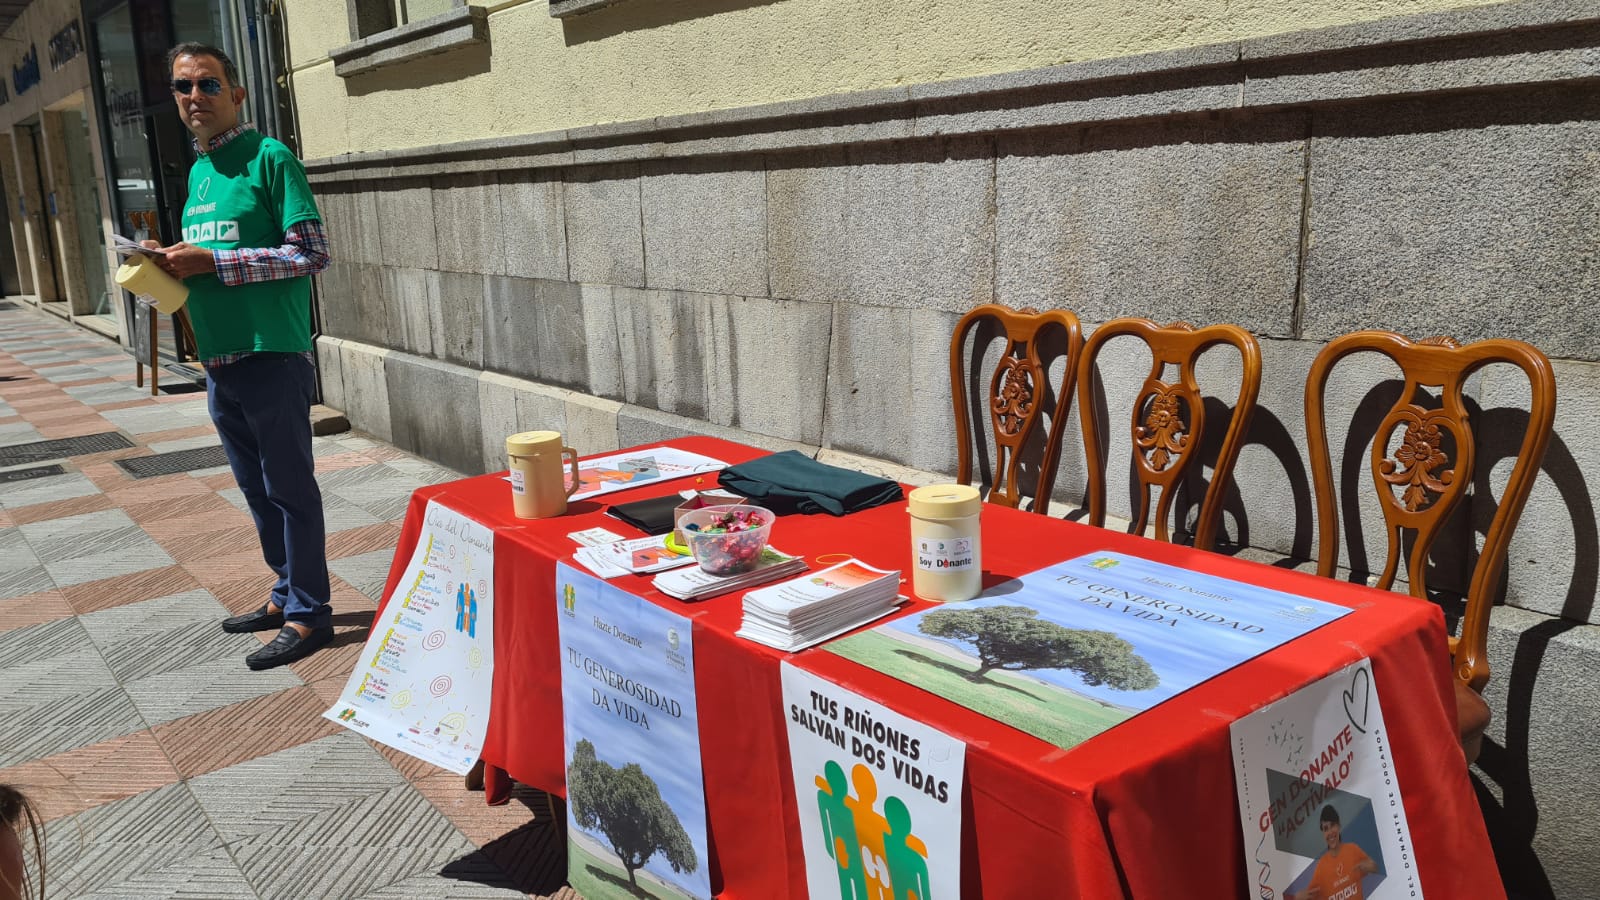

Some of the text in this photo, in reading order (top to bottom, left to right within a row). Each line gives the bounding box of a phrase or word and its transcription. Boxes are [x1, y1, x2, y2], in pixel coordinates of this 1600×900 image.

[919, 556, 972, 568] Soy Donante
[1055, 574, 1088, 588] TU
[1088, 582, 1265, 635] GENEROSIDAD
[1080, 595, 1179, 629] DA VIDA
[1178, 584, 1233, 603] Donante
[593, 615, 643, 649] Hazte Donante
[567, 646, 581, 668] TU
[584, 657, 682, 719] GENEROSIDAD
[592, 687, 650, 730] DA VIDA
[810, 690, 921, 761] TUS RIÑONES
[791, 704, 949, 804] SALVAN DOS VIDAS
[1259, 724, 1353, 833] GEN DONANTE
[1388, 792, 1398, 806] DE
[1394, 813, 1411, 869] DONANTE
[1408, 875, 1417, 898] DEL
